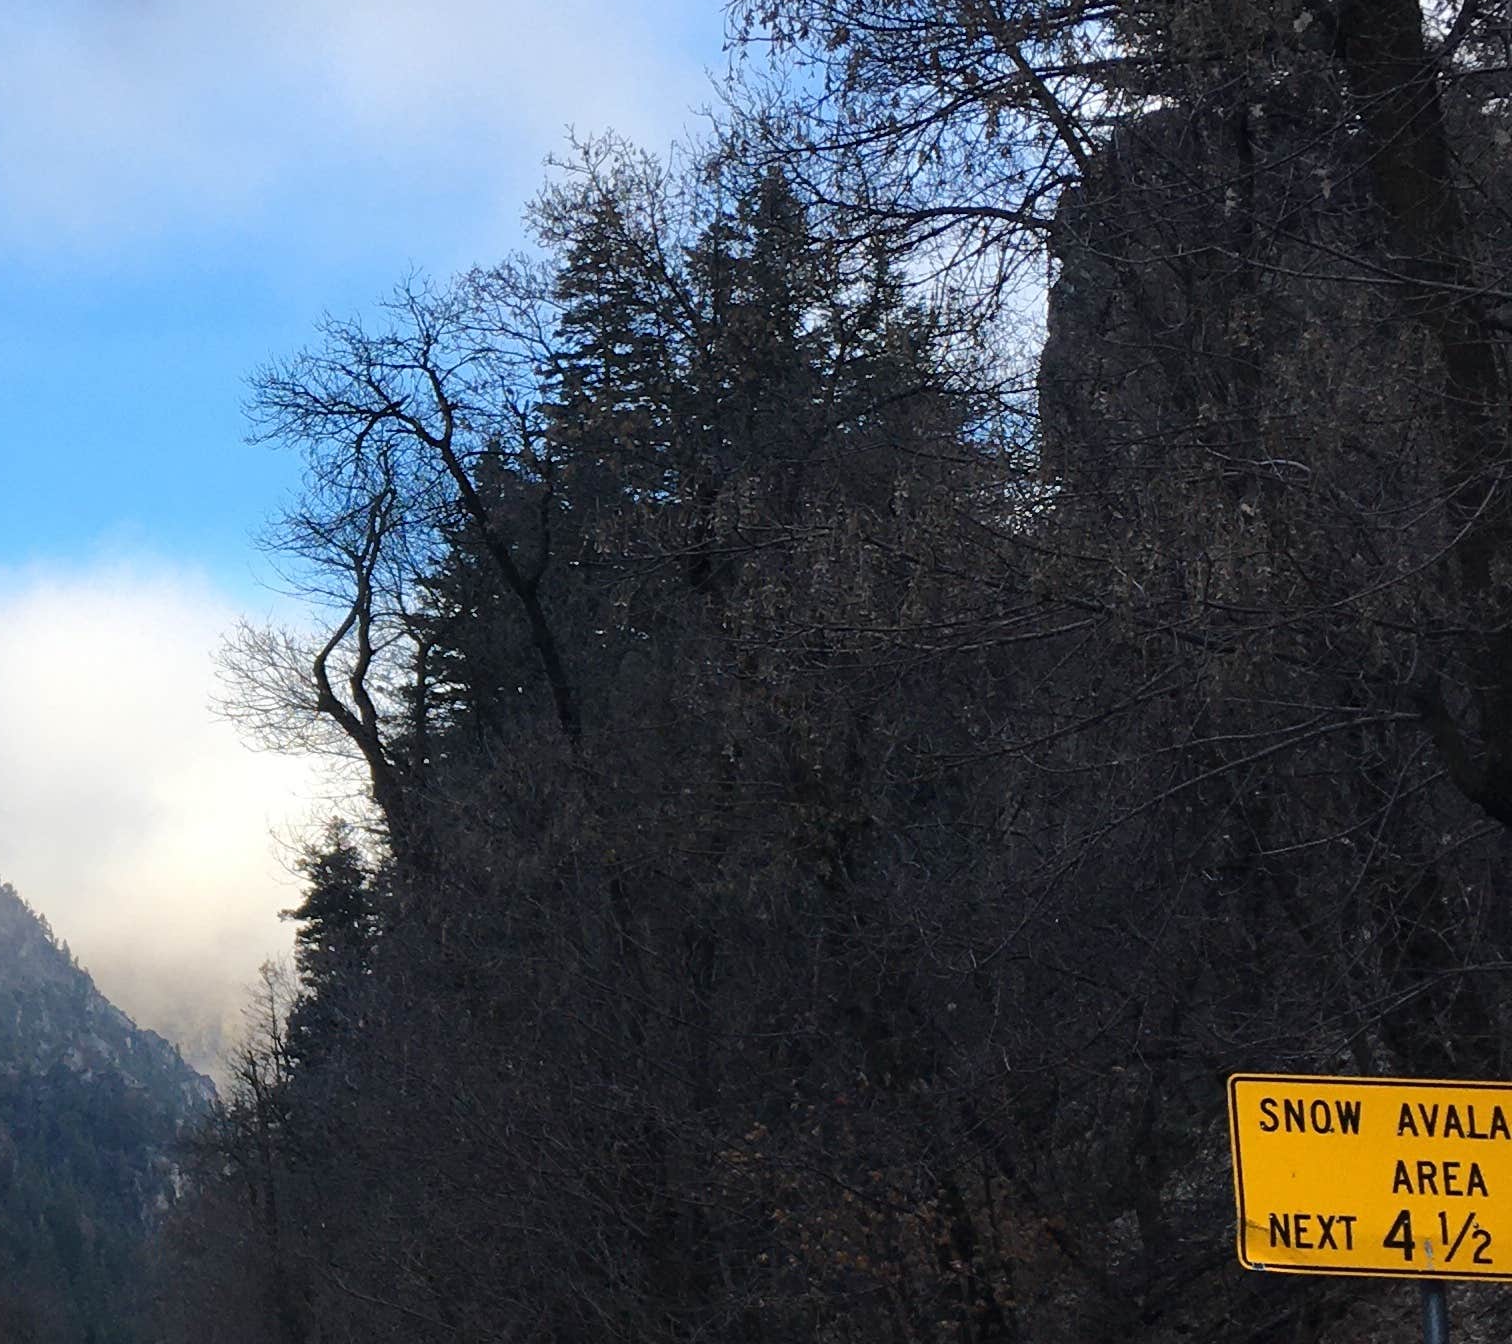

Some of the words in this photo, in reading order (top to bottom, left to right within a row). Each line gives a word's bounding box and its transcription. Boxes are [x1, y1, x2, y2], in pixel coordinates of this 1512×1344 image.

[1259, 1097, 1361, 1135] SNOW
[1397, 1102, 1512, 1140] AVALA
[1392, 1160, 1489, 1197] AREA
[1269, 1213, 1357, 1250] NEXT
[1383, 1209, 1415, 1261] 4
